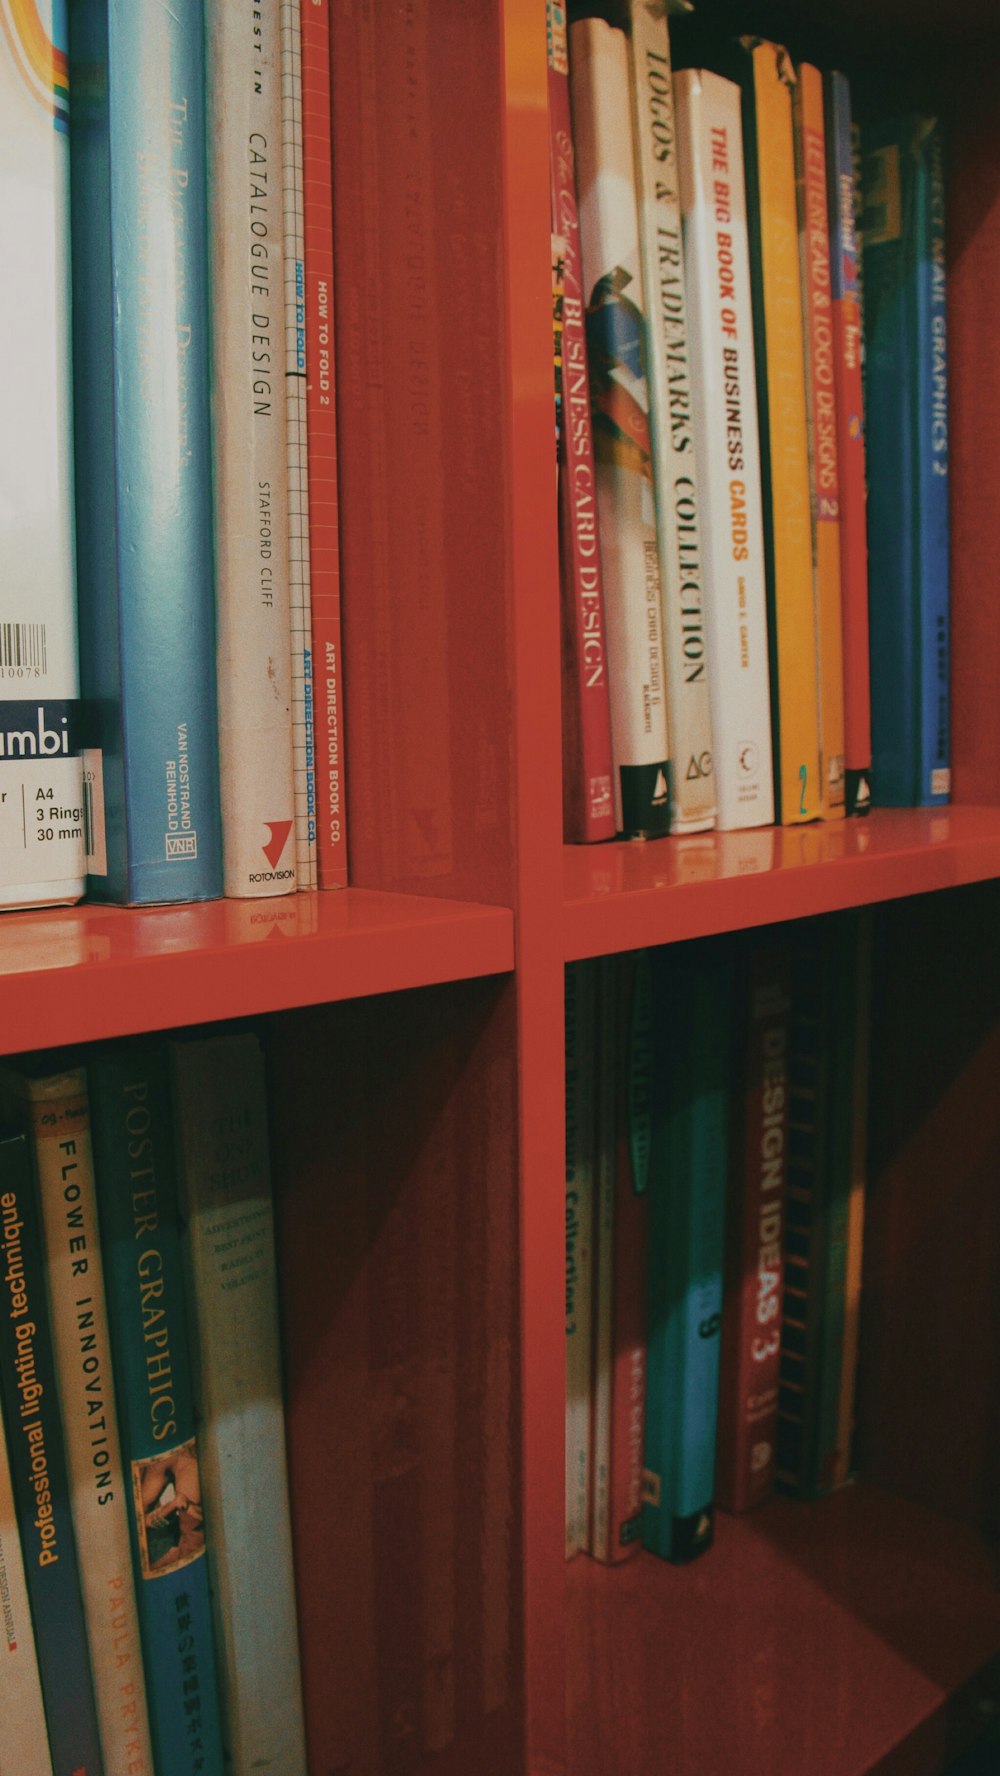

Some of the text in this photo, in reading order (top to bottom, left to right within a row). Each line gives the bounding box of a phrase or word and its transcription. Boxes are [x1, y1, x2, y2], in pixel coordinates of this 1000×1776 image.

[647, 51, 673, 162] LOGOS
[249, 0, 272, 416] EST IN CATALOGUE DESIGN
[296, 303, 305, 323] TO
[318, 281, 330, 405] HOW TO FOLD 2
[657, 227, 693, 454] TRADEMARKS
[710, 126, 750, 561] THE BIG BOOK OF BUSINESS CARDS
[813, 315, 834, 384] LOGO
[563, 297, 591, 456] BUSINESS
[816, 390, 837, 489] DESIGNS
[258, 482, 273, 608] STAFFORD CLIFF
[574, 463, 596, 558] CARD
[819, 499, 839, 517] 2
[579, 566, 605, 688] DESIGN
[674, 477, 706, 684] COLLECTION
[303, 648, 312, 678] ART
[177, 723, 192, 829] VAN NOSTRAND
[304, 684, 314, 767] DIRECTION
[325, 641, 341, 847] ART DIRECTION BOOK CO.
[35, 788, 54, 801] A4
[36, 808, 45, 821] 3
[37, 827, 82, 841] 30 mm
[165, 760, 178, 831] REINHOLD
[166, 838, 196, 854] VNR
[306, 771, 315, 815] BOOK
[249, 869, 295, 883] ROTOVISION
[759, 1028, 786, 1191] DESIGN
[123, 1078, 177, 1441] POSTER GRAPHICS
[755, 1199, 783, 1324] IDEAS
[58, 1139, 89, 1277] FLOWER
[75, 1297, 114, 1506] INNOVATIONS
[751, 1330, 781, 1362] 3
[1, 1192, 59, 1568] Professional lighting technique
[2, 1602, 16, 1643] ANNUAL
[107, 1577, 145, 1776] PAULA PRYKE
